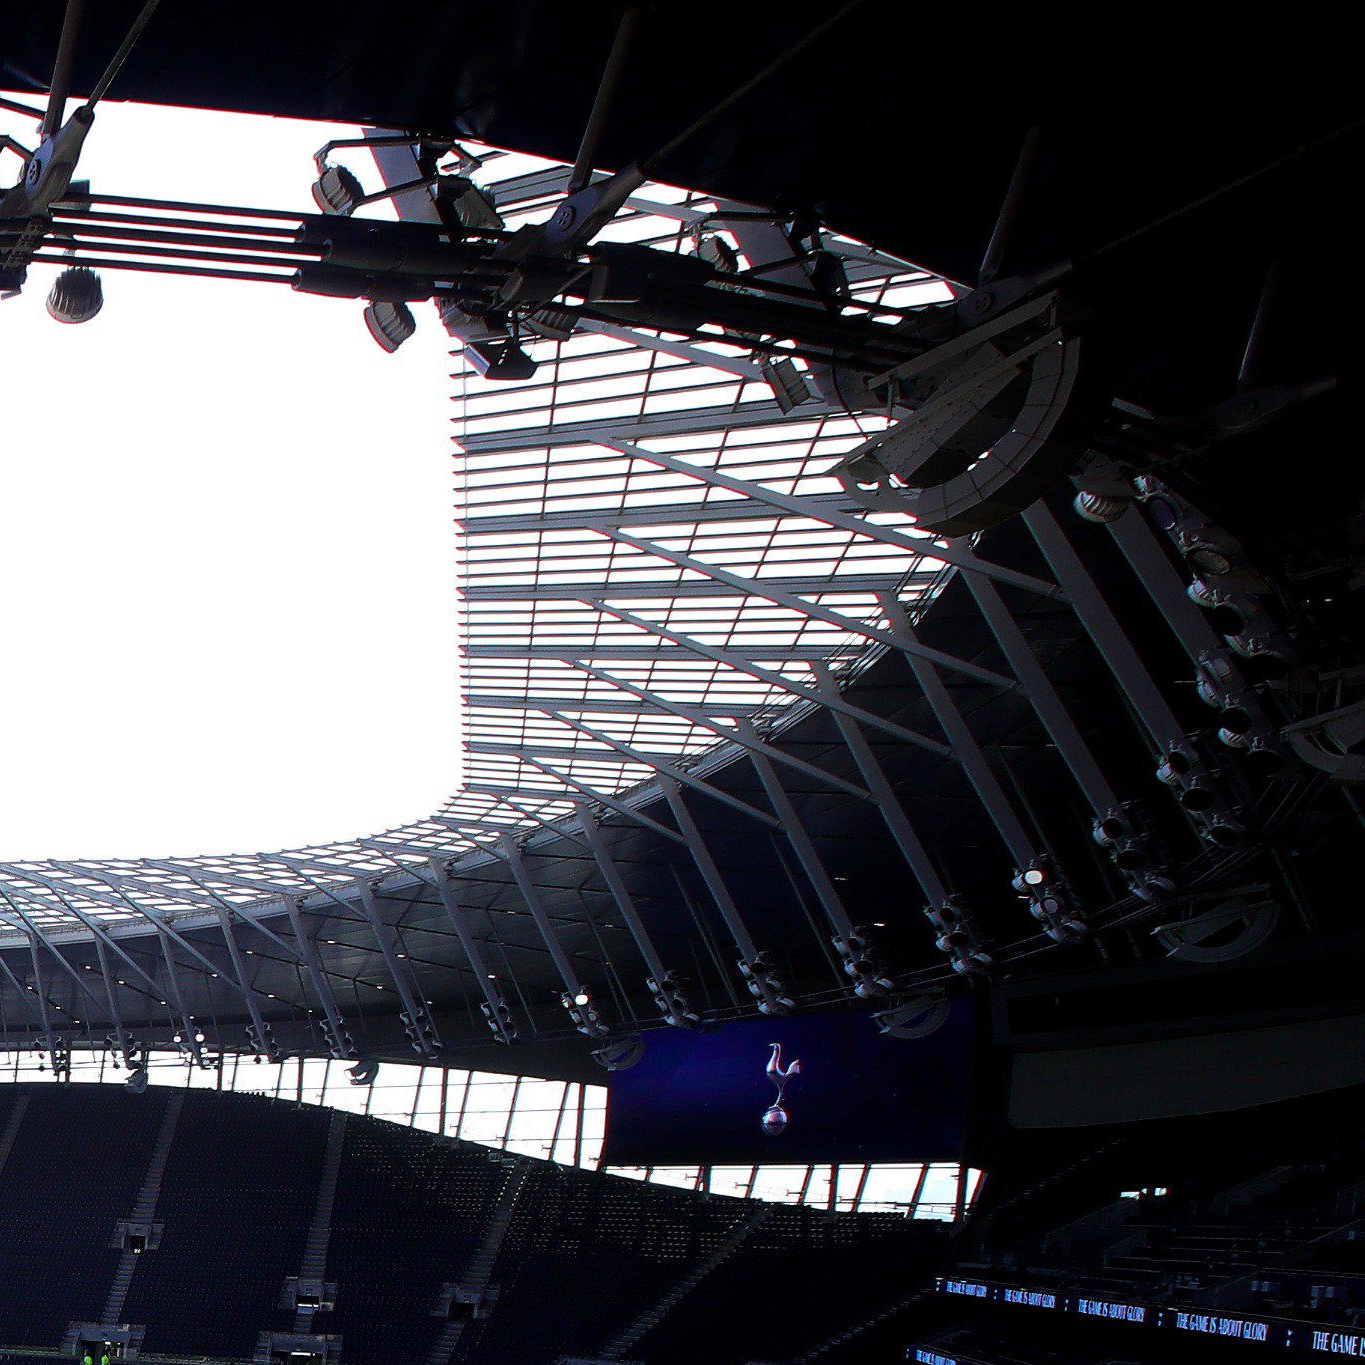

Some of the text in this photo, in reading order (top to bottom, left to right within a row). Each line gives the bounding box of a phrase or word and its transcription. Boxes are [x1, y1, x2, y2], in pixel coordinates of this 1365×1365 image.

[1177, 1313, 1268, 1341] THE GAME IS ABOUT GLORY
[1313, 1331, 1329, 1350] THE
[1332, 1333, 1357, 1356] GAME
